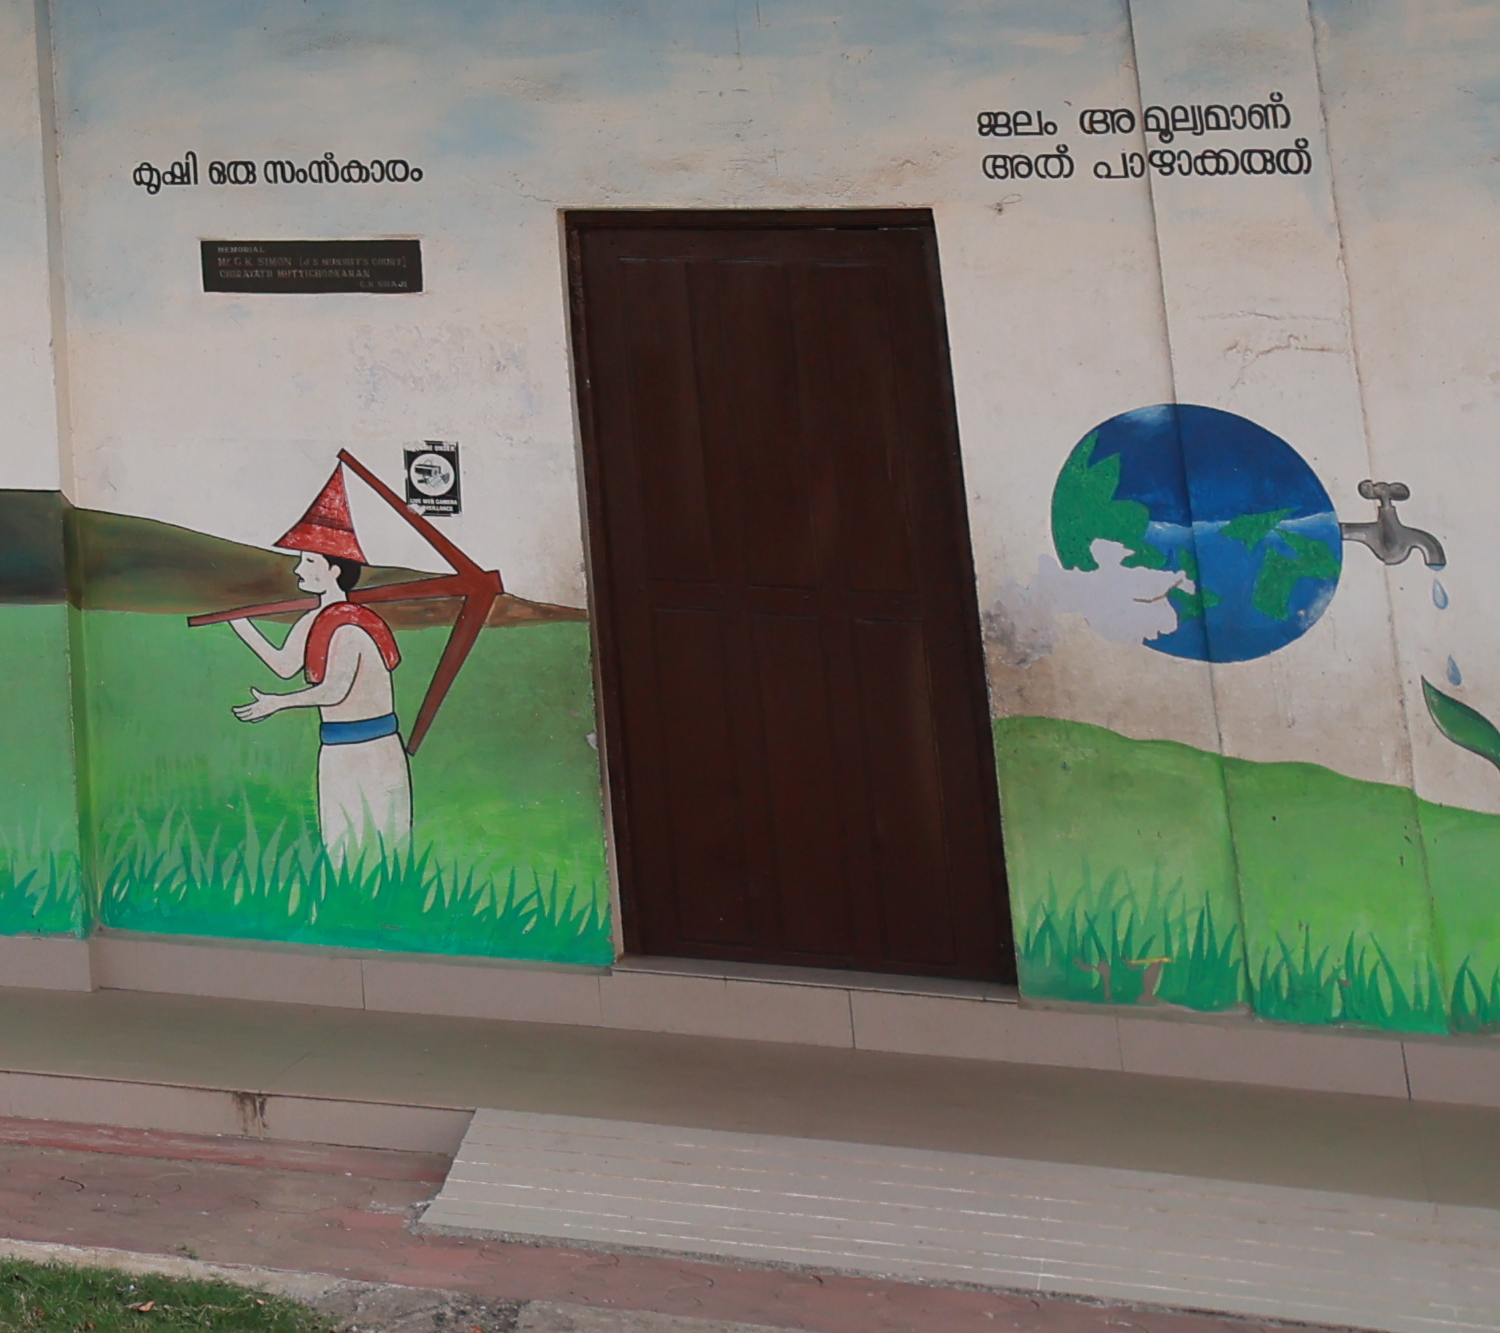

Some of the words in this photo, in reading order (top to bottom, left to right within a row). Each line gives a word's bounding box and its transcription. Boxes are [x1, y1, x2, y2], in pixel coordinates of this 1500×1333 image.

[977, 109, 1058, 137] ജലം
[133, 151, 199, 195] കൃഷി
[208, 160, 257, 185] ഒരു
[263, 151, 423, 184] സംസ്കാരം
[982, 144, 1074, 180] അത്
[257, 257, 292, 267] SIMON
